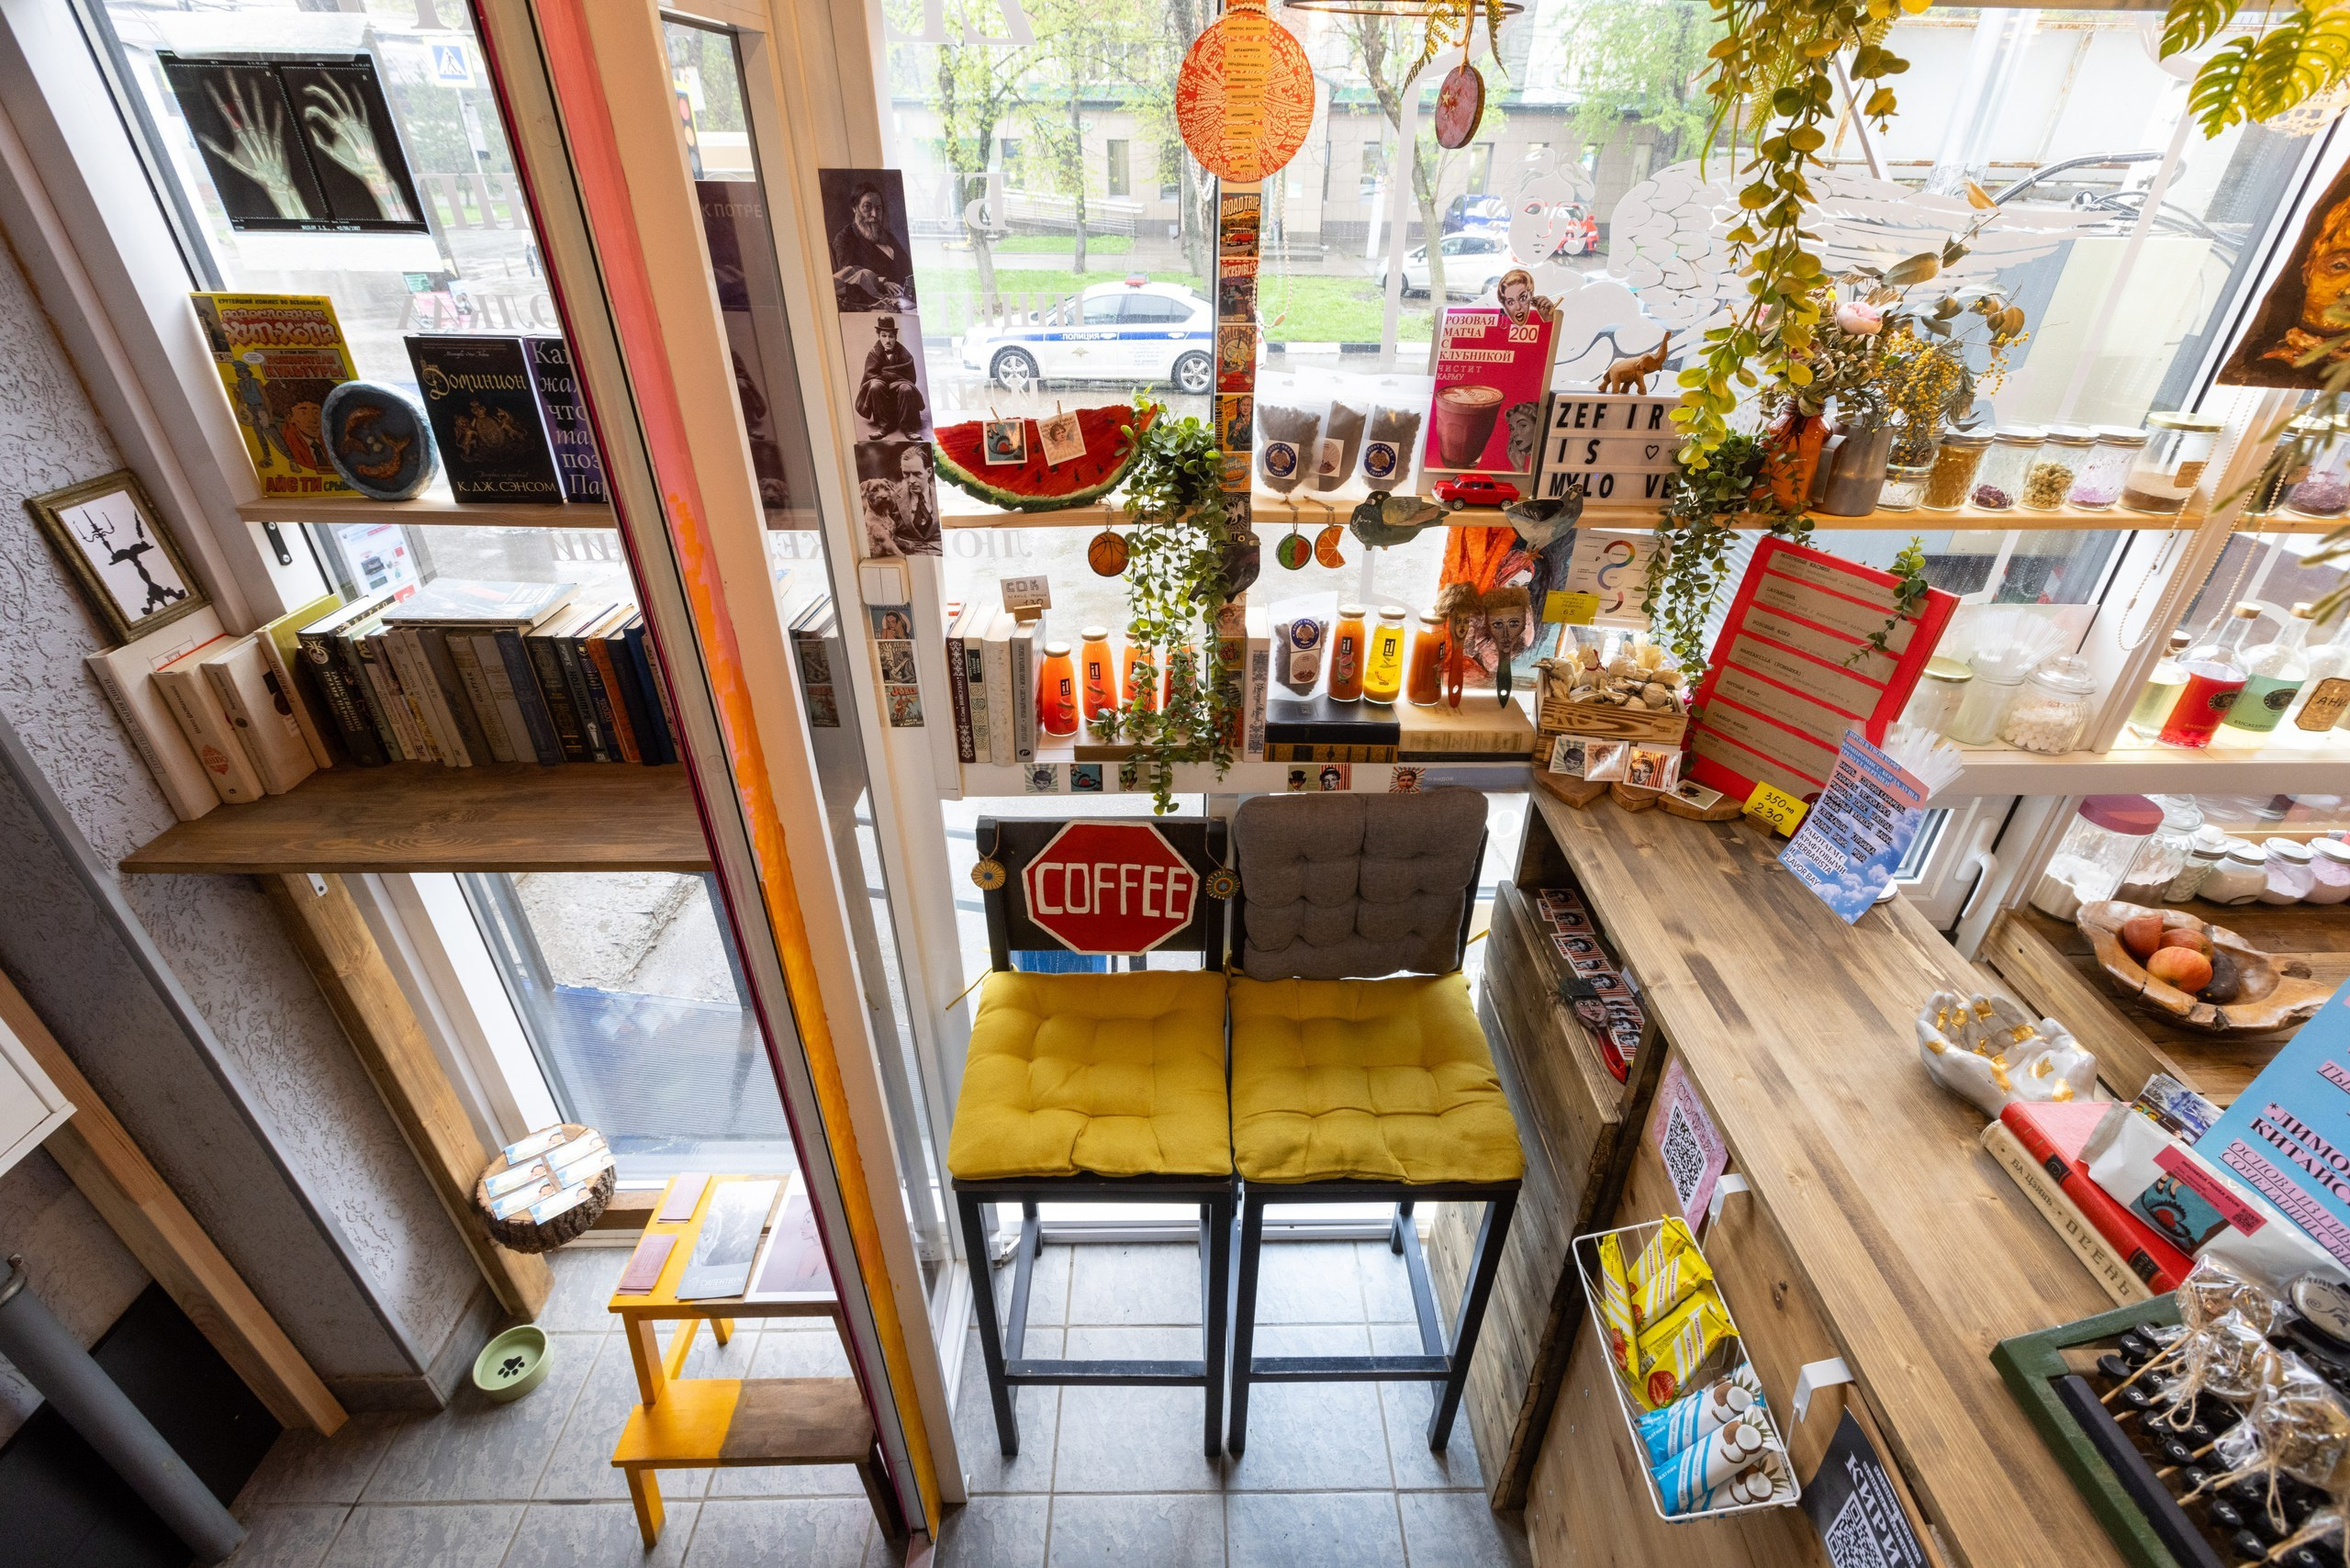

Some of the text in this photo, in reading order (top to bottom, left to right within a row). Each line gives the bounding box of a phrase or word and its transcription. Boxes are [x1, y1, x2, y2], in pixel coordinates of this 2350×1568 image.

[1223, 196, 1260, 217] ROAD TRIP
[1221, 263, 1257, 278] INCREDIBLES
[221, 308, 328, 321] РОДОСЛОВНАЯ
[1445, 314, 1496, 327] РОЗОВАЯ
[1062, 332, 1101, 341] ПОЛИЦИЯ
[1441, 339, 1449, 350] С
[1443, 327, 1483, 338] МАТЧА
[1509, 327, 1539, 342] 200
[1438, 349, 1513, 364] КЛУБНИКОЙ
[1438, 364, 1483, 374] ЧИСТИТ
[266, 366, 346, 378] КУЛЬТУРЫ
[421, 365, 527, 400] Доминион
[1437, 373, 1466, 381] КАРМУ
[1557, 438, 1600, 465] IS
[266, 475, 322, 492] АЙС ТИ
[498, 481, 558, 493] СЭНСОМ
[1005, 579, 1040, 593] СОК
[1739, 646, 1772, 664] MANZANILLA
[103, 676, 121, 701] КНИГИ
[330, 668, 363, 734] ТАИНСТВЕННОЕ
[567, 668, 592, 722] ВАШИНГТОН
[116, 699, 134, 724] МАГИЯ
[322, 669, 355, 734] ПЛАМЯ ЦАРИЦЫ
[598, 696, 612, 722] ГОГОЛЬ
[1844, 728, 1866, 746] СИРОП
[1883, 756, 1901, 771] КОФЕ
[1840, 746, 1891, 787] ТРЕБУЕТ ПЕРЕМЕН
[1833, 770, 1859, 792] КАРАМЕЛЬ
[1875, 802, 1892, 818] ОРЕХ
[1838, 759, 1857, 778] ВАНИЛЬ
[1878, 790, 1907, 814] КАРАМЕЛЬ
[1880, 769, 1901, 788] КОГДА
[1898, 782, 1919, 801] ДУША
[1764, 792, 1786, 808] 350
[1822, 796, 1841, 813] ПРЯНИК
[1829, 779, 1895, 834] МИНДАЛЬ КОКОС ШОКОЛАД
[1803, 825, 1845, 863] РАБОТАЕМ С
[1811, 815, 1867, 864] МАЛИНА ВИШНЯ МЯТА
[1850, 832, 1876, 856] КЛУБНИКА
[1874, 828, 1893, 846] БАНАН
[1788, 846, 1796, 855] И
[1793, 838, 1832, 875] HERBARISTA
[1798, 832, 1847, 876] КРАФТОВЫМИ
[1782, 851, 1819, 888] FLAVOR BAY
[1034, 861, 1189, 920] COFFEE
[2250, 1116, 2350, 1207] КИТАЙС
[2179, 1159, 2226, 1198] INDONESIA FRINSA
[2231, 1141, 2321, 1214] ОСНОВА ИЗ
[2221, 1151, 2333, 1244] СОЧЕТАНИИ С
[2009, 1158, 2026, 1174] БА
[2058, 1217, 2138, 1297] ОСЕНЬ
[700, 1275, 744, 1288] СИЛЕНТИУМ
[1684, 1416, 1692, 1438] КОКОС
[1693, 1454, 1701, 1476] КОКОС
[1834, 1450, 1910, 1568] КИРИ
[1893, 1513, 1925, 1563] ХАРИЗМА
